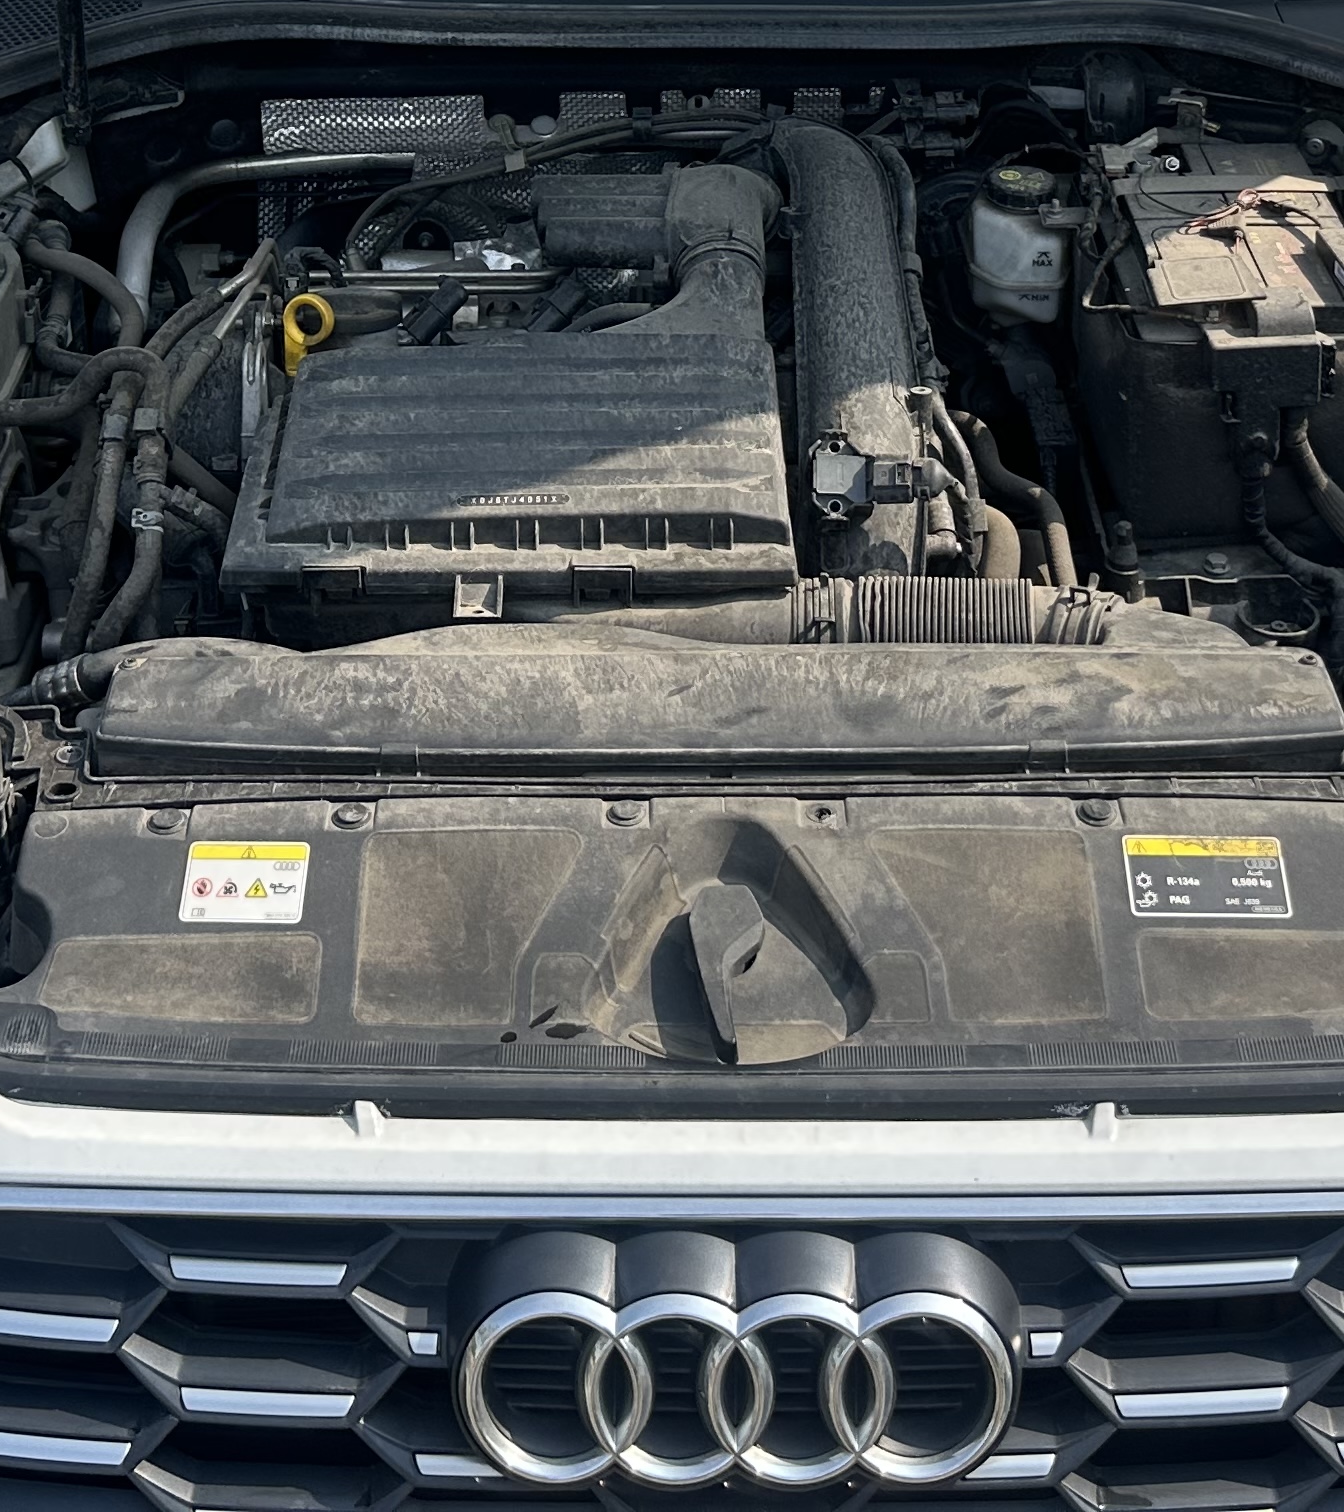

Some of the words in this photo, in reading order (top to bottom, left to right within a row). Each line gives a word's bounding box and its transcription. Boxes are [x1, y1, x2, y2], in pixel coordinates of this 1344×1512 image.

[1032, 259, 1053, 267] MAX
[1166, 876, 1200, 886] R-134a
[1260, 878, 1273, 888] kg
[1169, 895, 1191, 905] PAG
